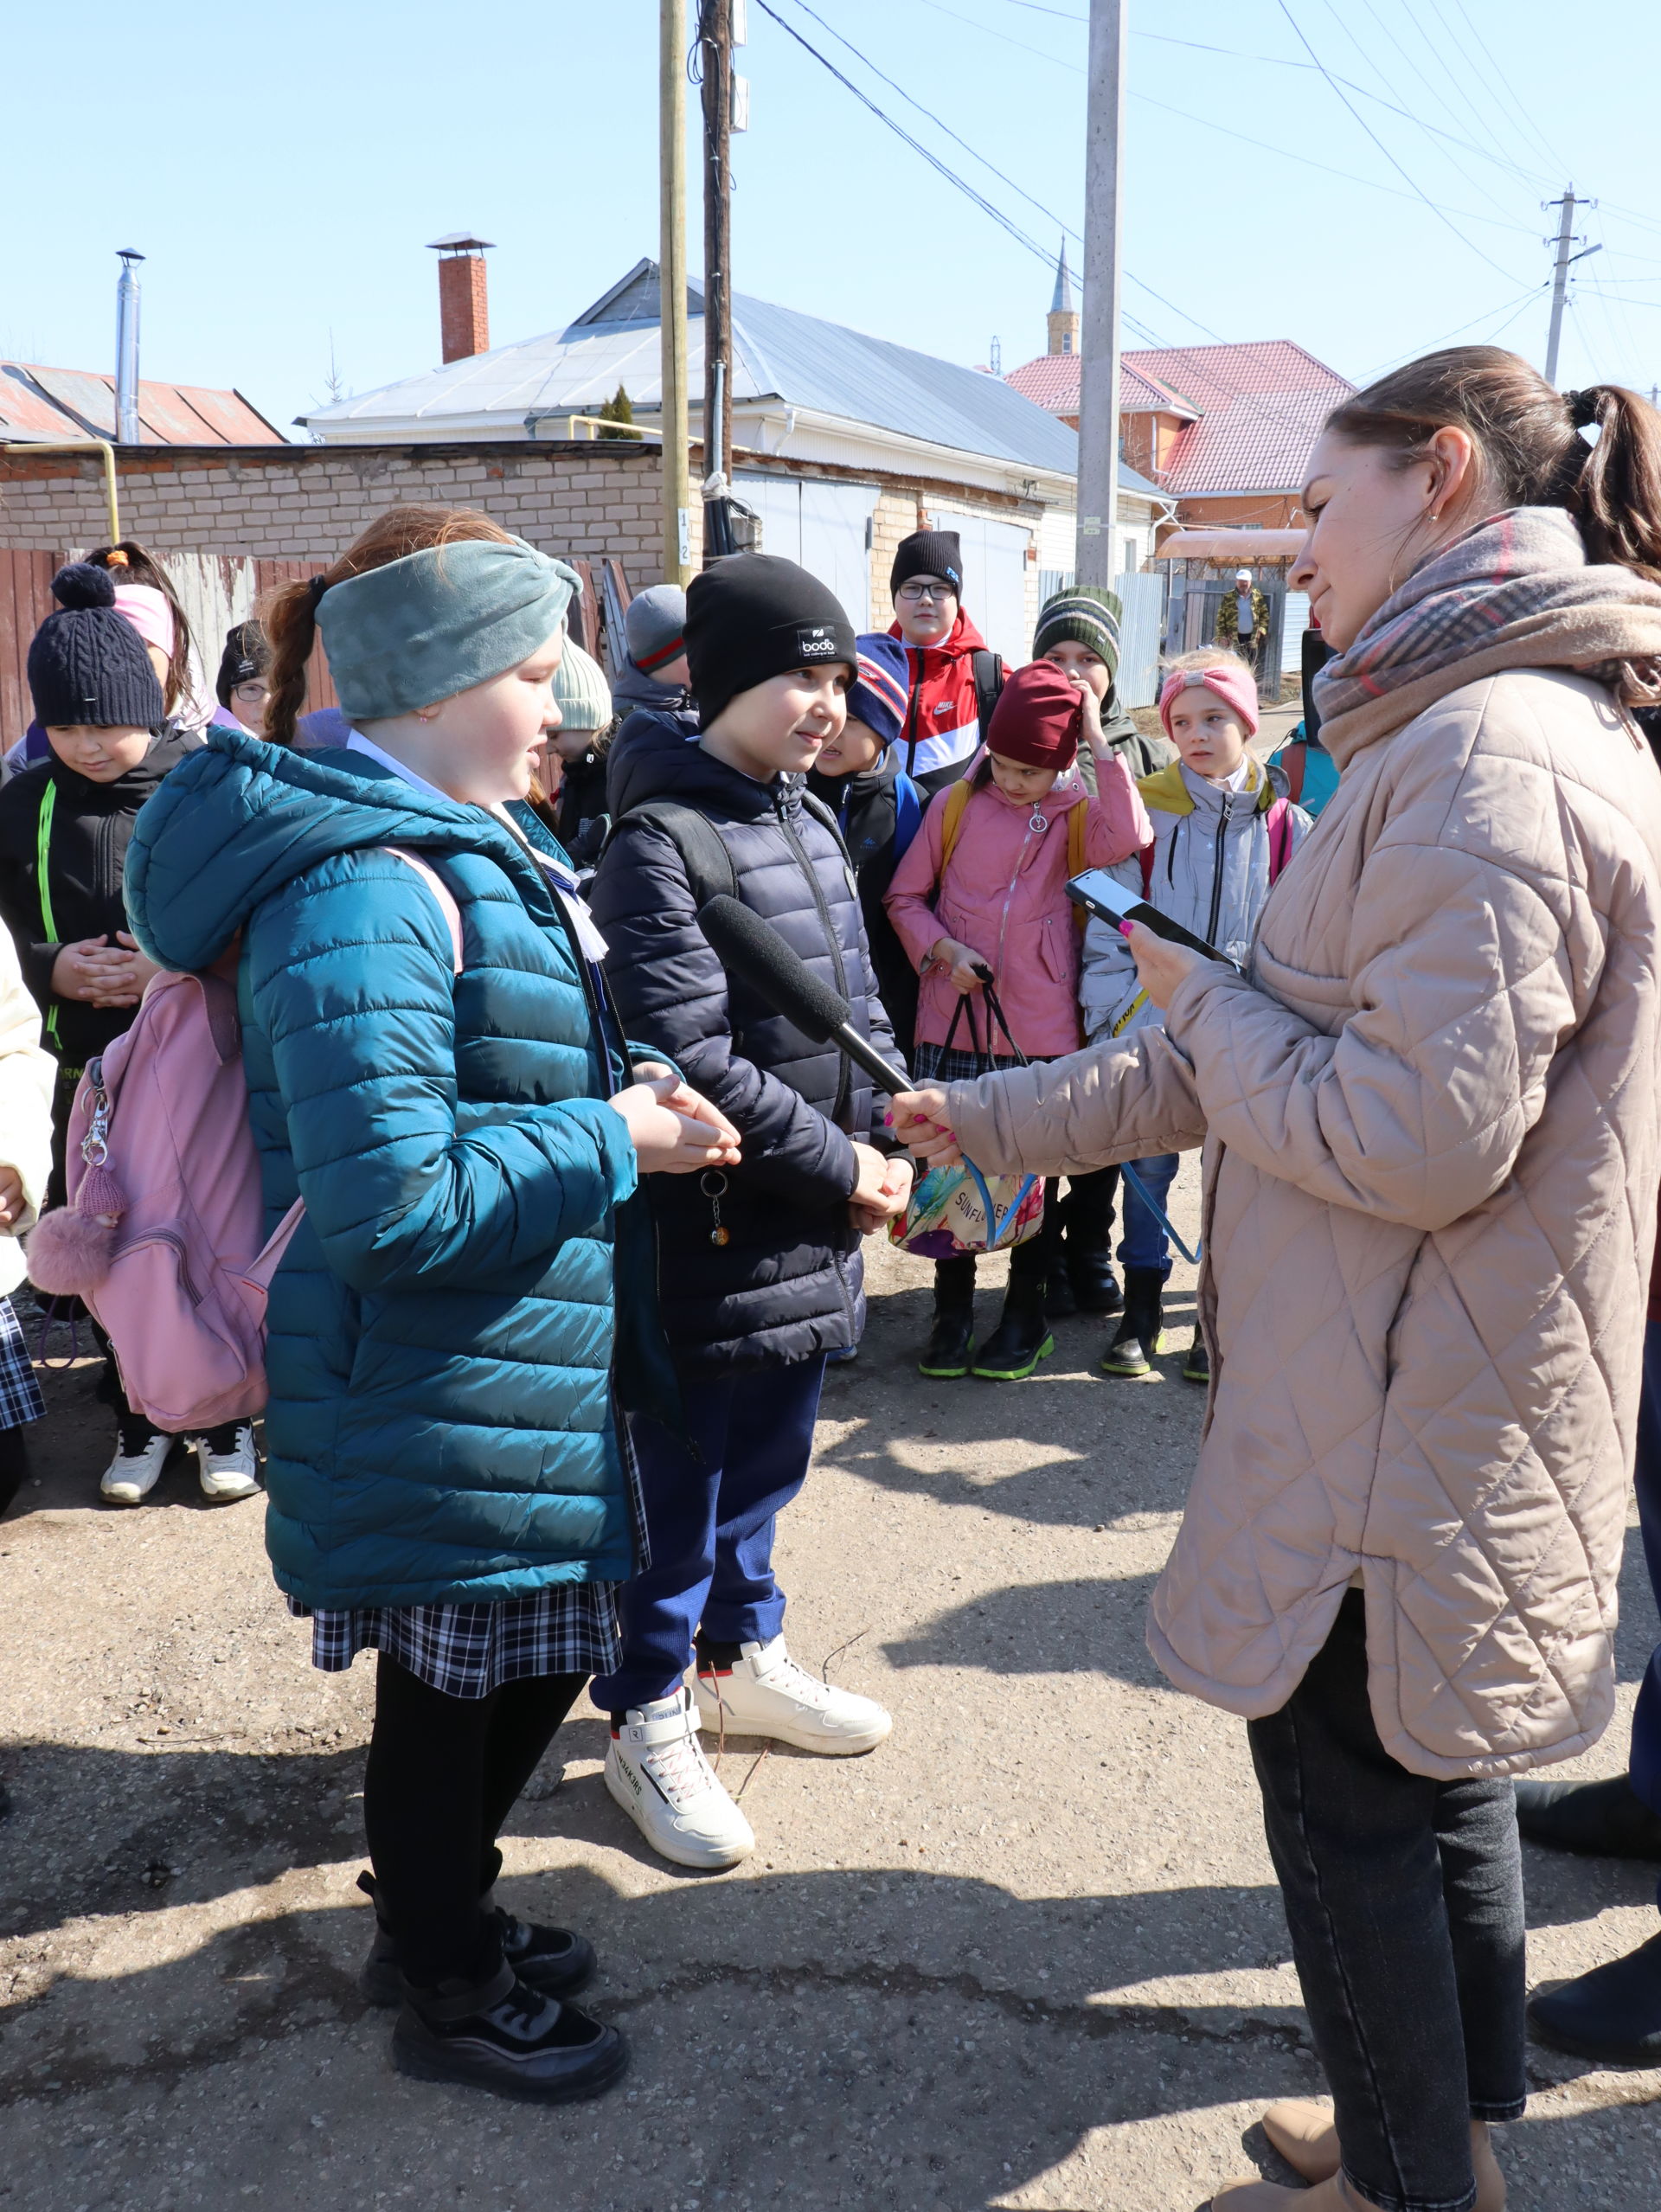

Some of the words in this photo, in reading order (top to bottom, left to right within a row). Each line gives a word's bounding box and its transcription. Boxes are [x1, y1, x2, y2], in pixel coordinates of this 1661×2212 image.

[681, 513, 687, 527] 1
[682, 546, 689, 559] 2
[802, 640, 835, 652] bodo
[937, 701, 954, 709] NIKE
